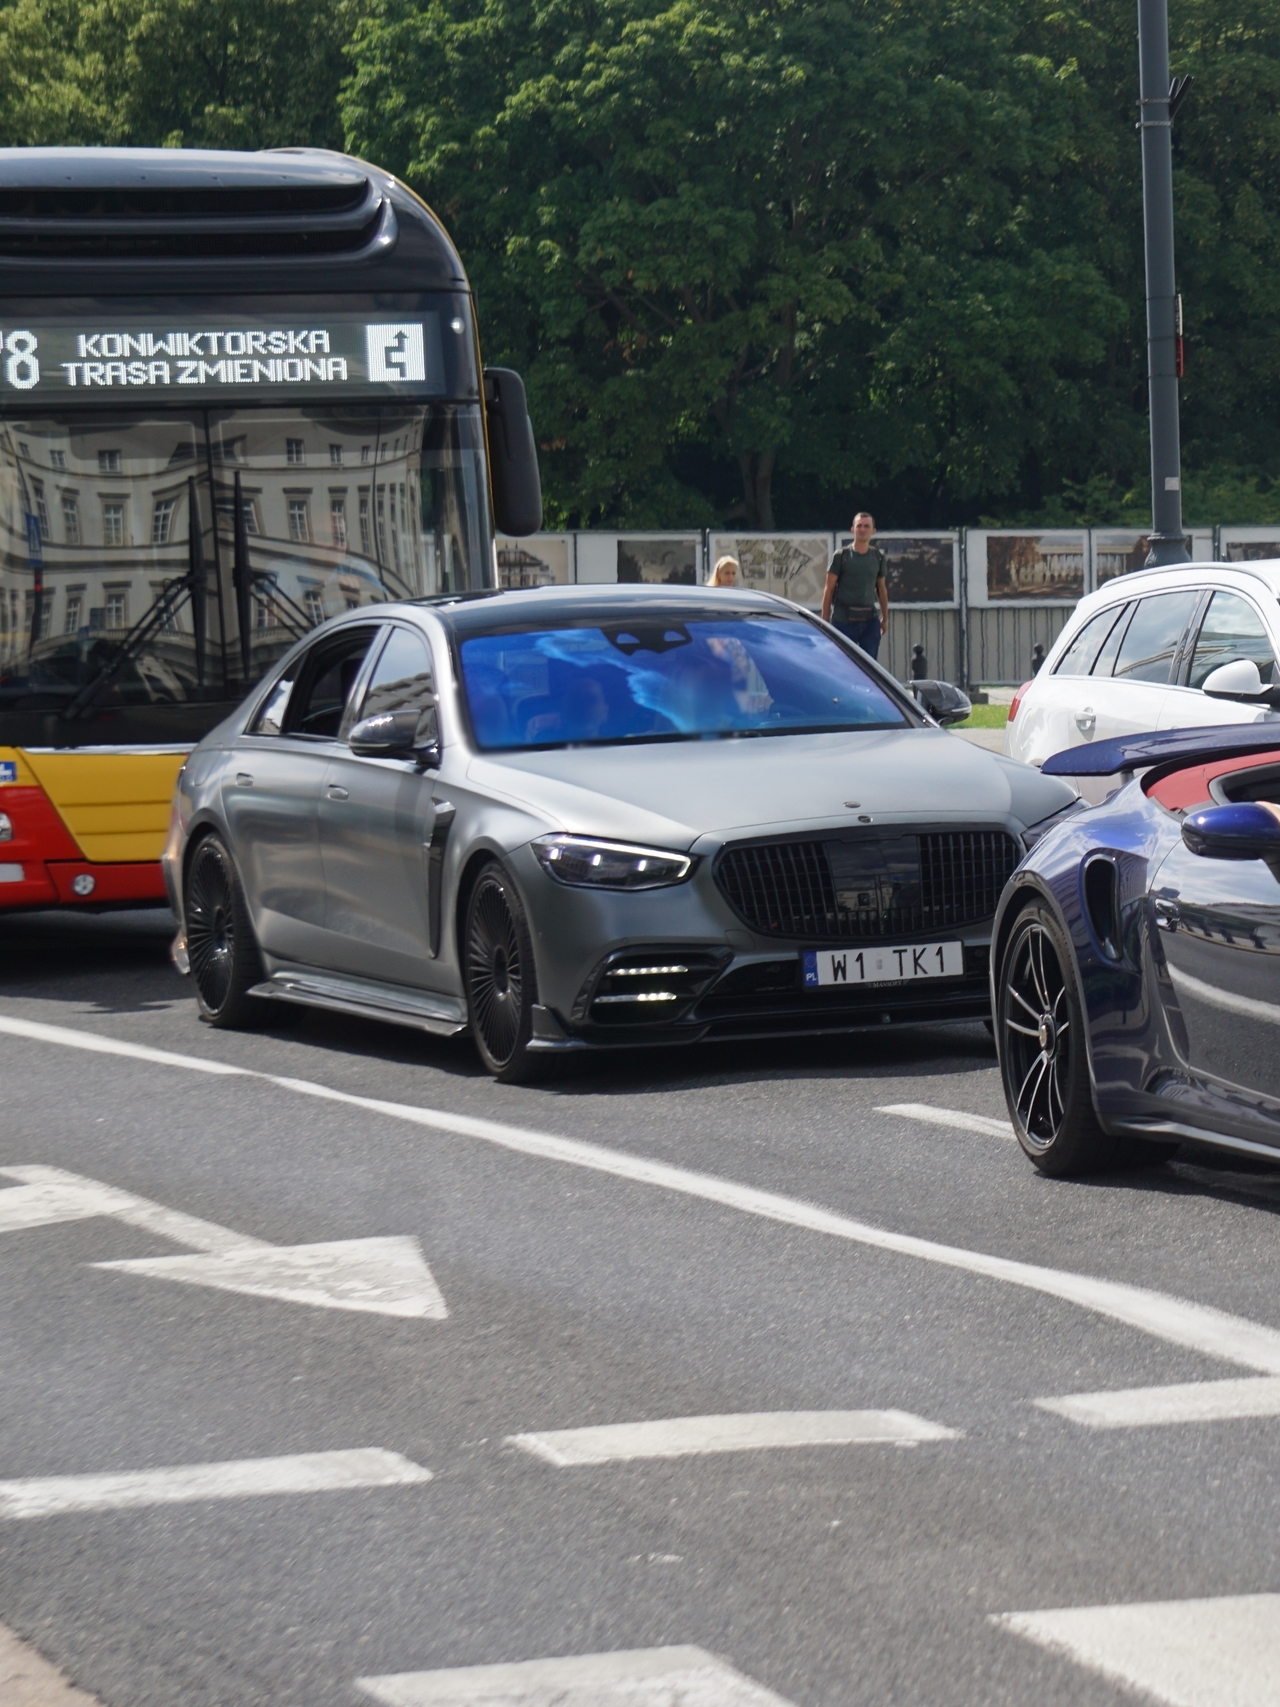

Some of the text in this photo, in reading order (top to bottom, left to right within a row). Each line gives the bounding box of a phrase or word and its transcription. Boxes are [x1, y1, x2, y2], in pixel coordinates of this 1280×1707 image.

[77, 330, 330, 358] KONWIKTORSKA
[0, 330, 40, 390] 8
[60, 357, 348, 387] TRASA ZMIENIONA
[806, 972, 818, 982] PL
[831, 946, 945, 982] W1 TK1
